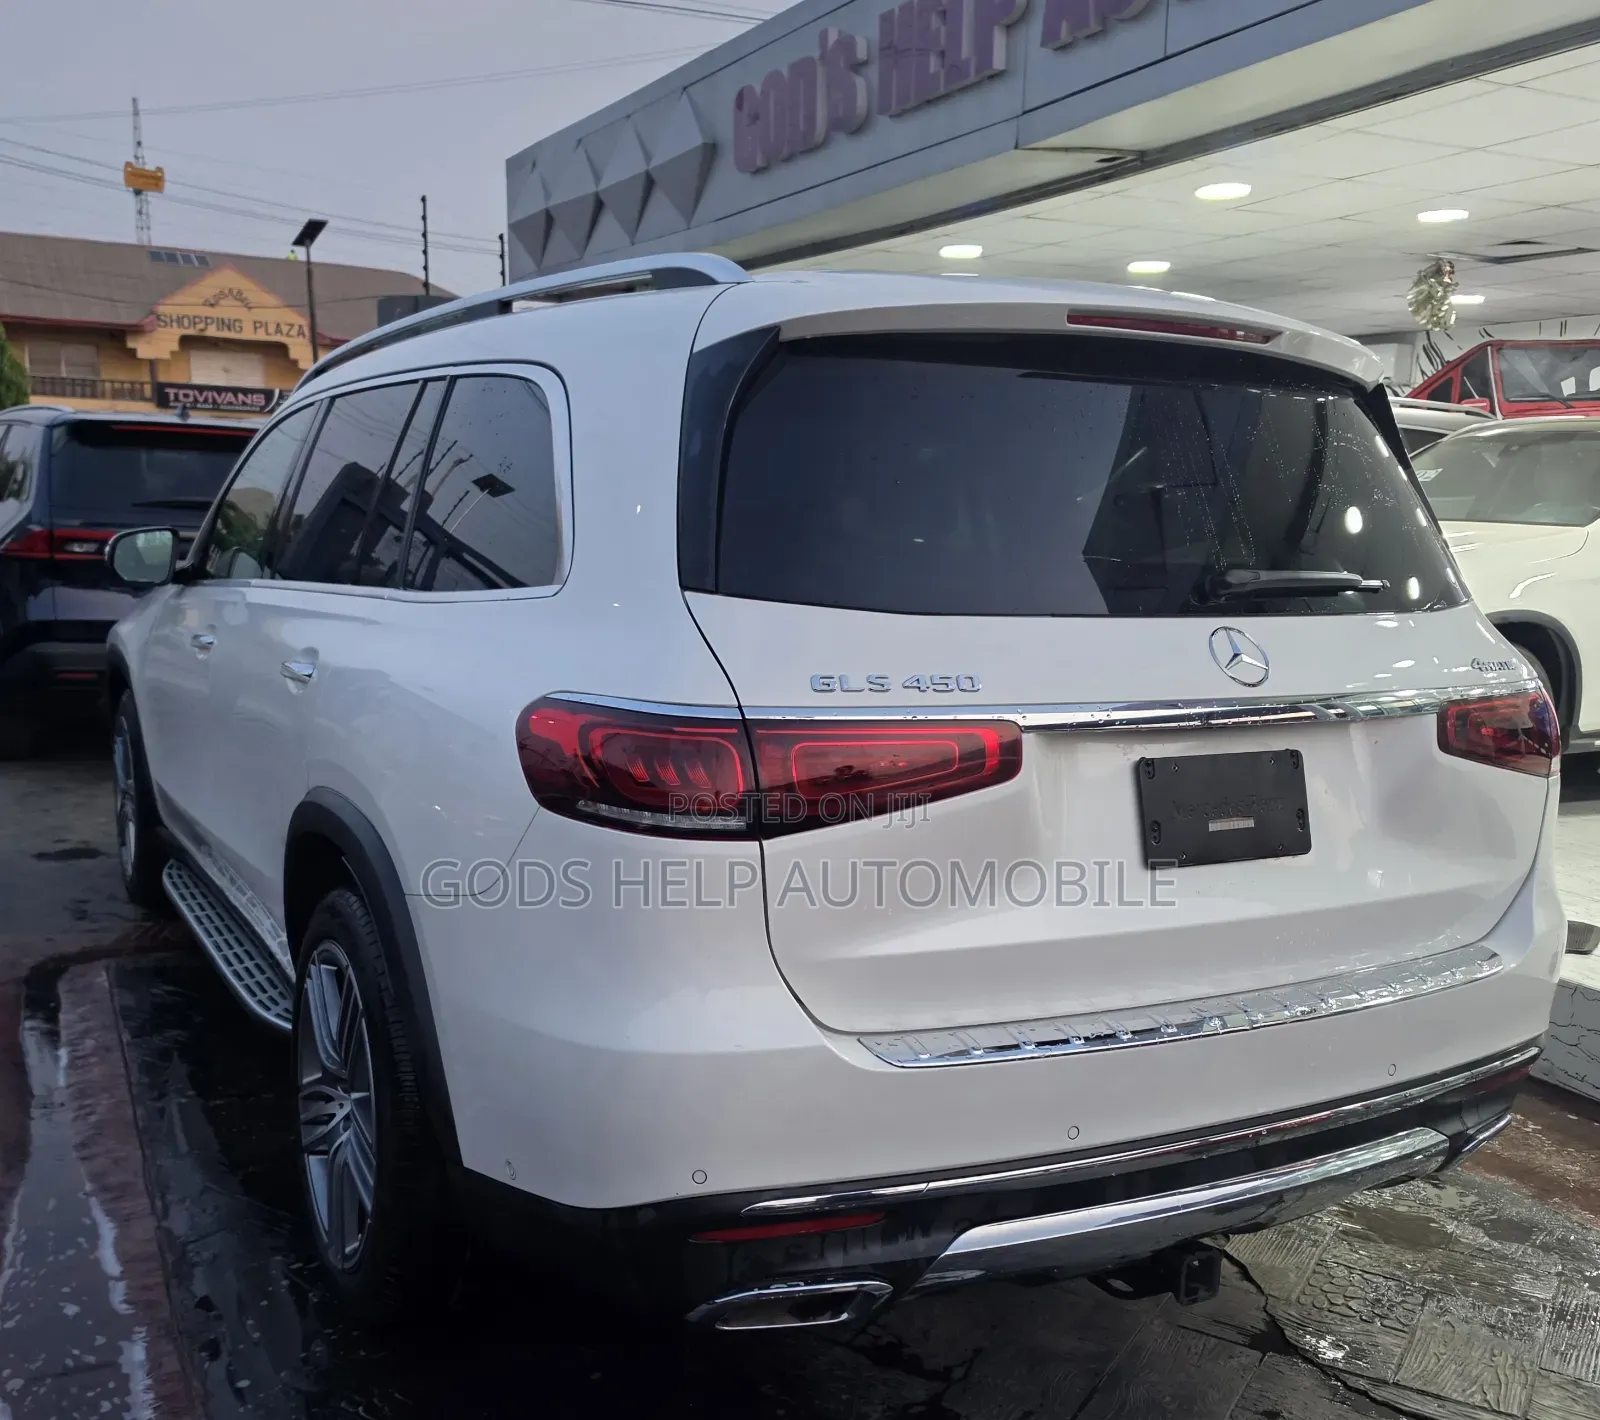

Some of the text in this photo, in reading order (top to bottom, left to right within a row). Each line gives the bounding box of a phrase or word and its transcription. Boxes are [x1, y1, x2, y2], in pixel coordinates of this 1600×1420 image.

[876, 0, 1030, 118] HELP
[156, 312, 307, 339] SHOPPING PLAZA
[164, 387, 266, 407] TOVIVANS
[810, 673, 982, 693] GLS 450
